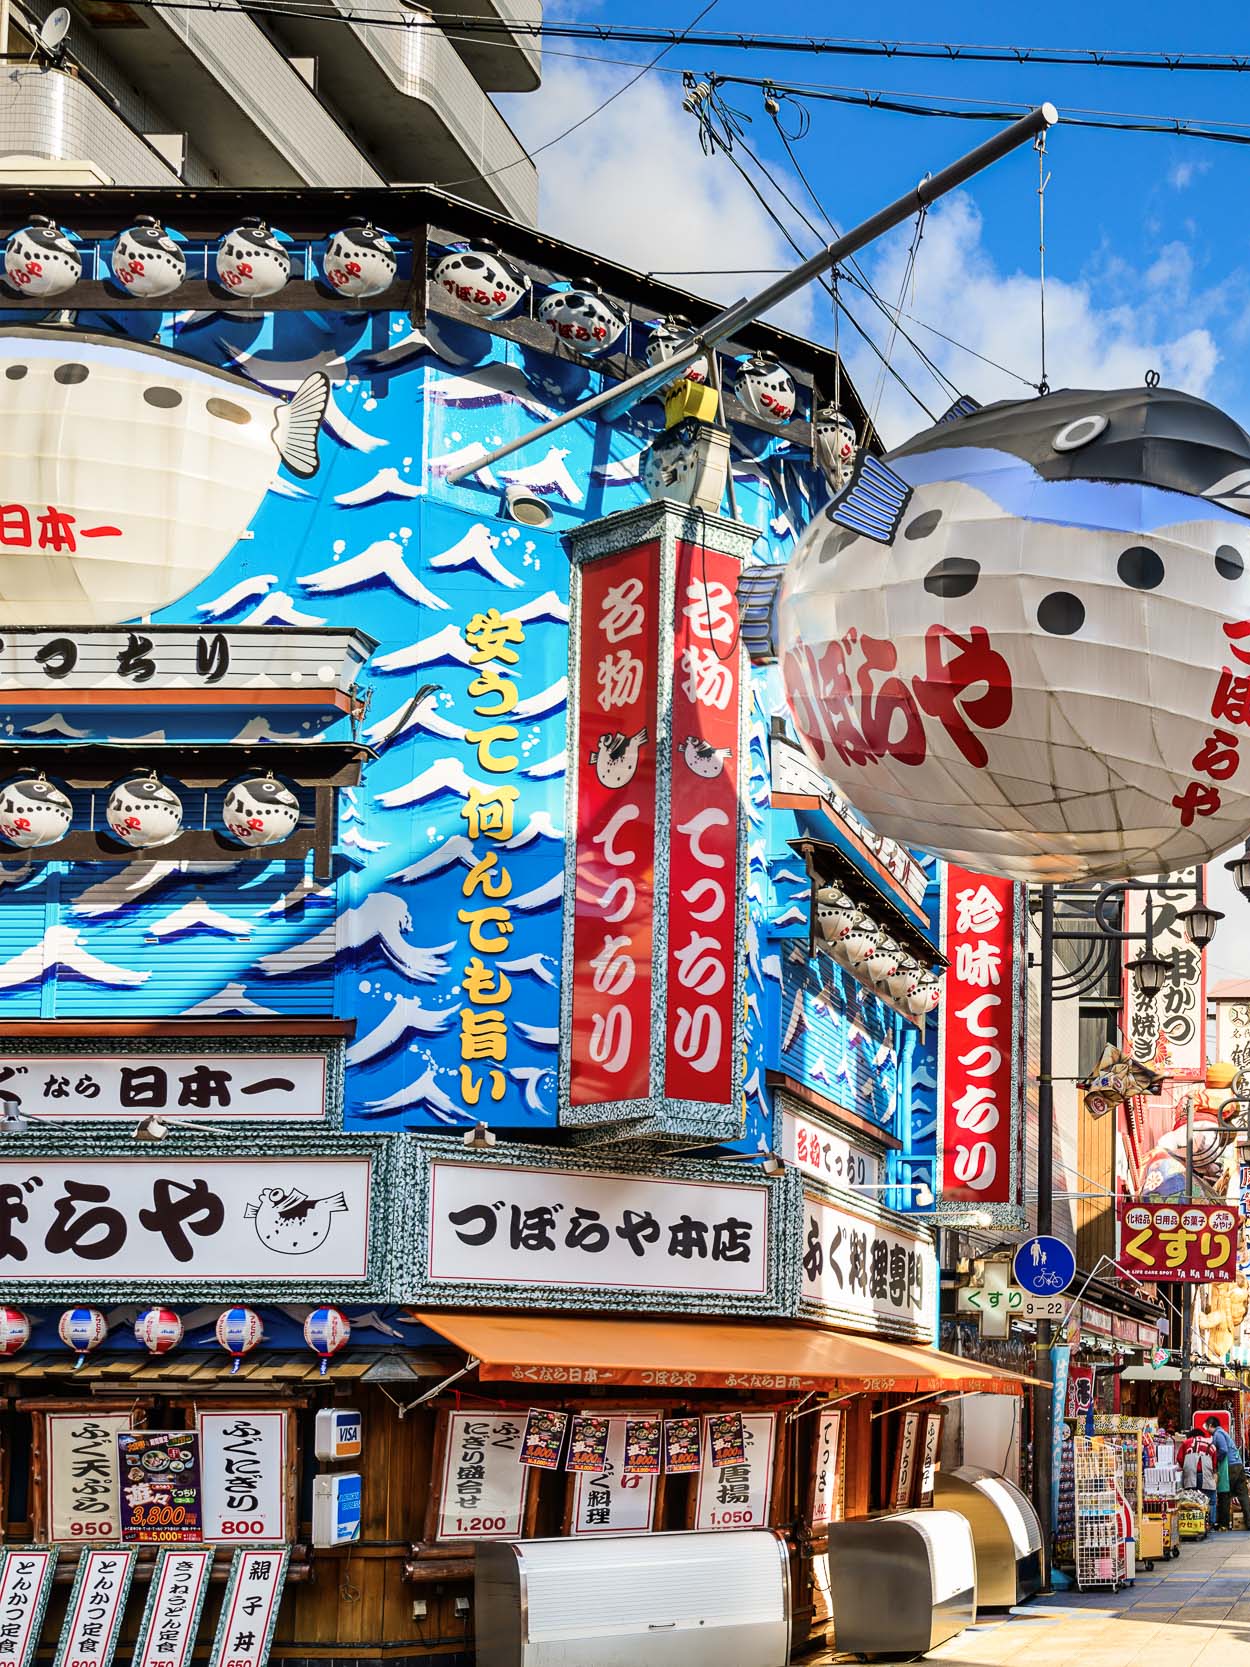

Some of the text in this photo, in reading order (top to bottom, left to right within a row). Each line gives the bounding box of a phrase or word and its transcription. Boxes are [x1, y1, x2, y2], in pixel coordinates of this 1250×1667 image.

[0, 504, 122, 552] 日本一
[597, 577, 644, 711] 名物
[680, 576, 737, 711] 名物
[448, 1199, 753, 1264] づぼらや本店
[1125, 1229, 1231, 1268] くすり
[1155, 1215, 1178, 1226] 日用品
[803, 1215, 923, 1311] ふぐ料理専門
[967, 1291, 1022, 1308] くすり
[71, 1422, 112, 1513] ふぐ天ぷら
[223, 1421, 262, 1512] ふぐにぎり
[340, 1427, 358, 1442] VISA
[70, 1522, 112, 1536] 950
[221, 1520, 264, 1534] 800
[78, 1561, 117, 1653] とんかつ定食
[156, 1561, 194, 1653] きつねうどん定食
[233, 1560, 271, 1652] 親子丼
